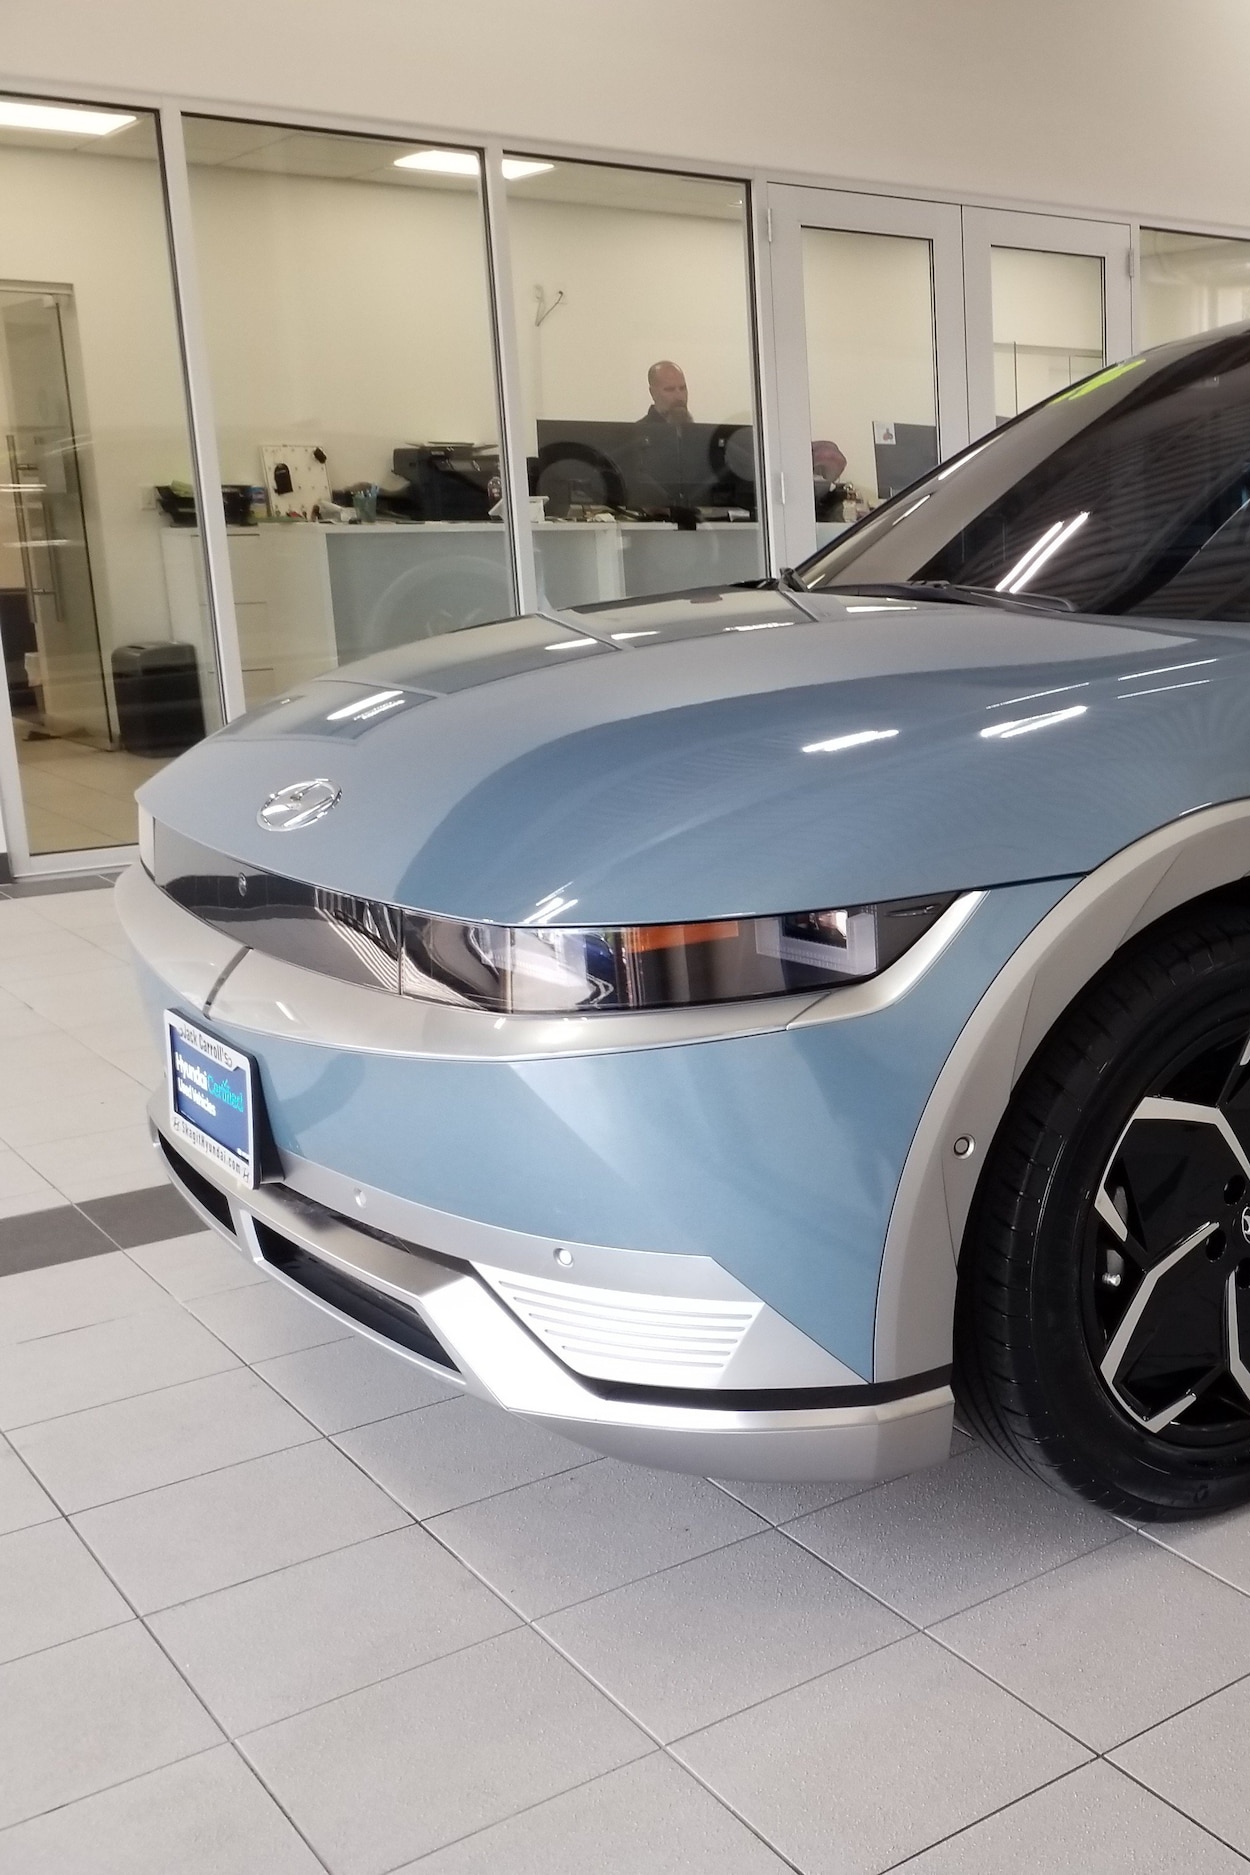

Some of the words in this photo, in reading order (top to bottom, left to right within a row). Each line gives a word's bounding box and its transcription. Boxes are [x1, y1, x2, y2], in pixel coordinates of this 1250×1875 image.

[183, 1023, 198, 1044] Jack
[199, 1033, 230, 1066] Carroll's
[175, 1051, 208, 1091] Hyundai
[207, 1074, 244, 1113] Certified
[191, 1088, 216, 1117] Vehicles
[181, 1121, 241, 1175] SkagitHyundai.com
